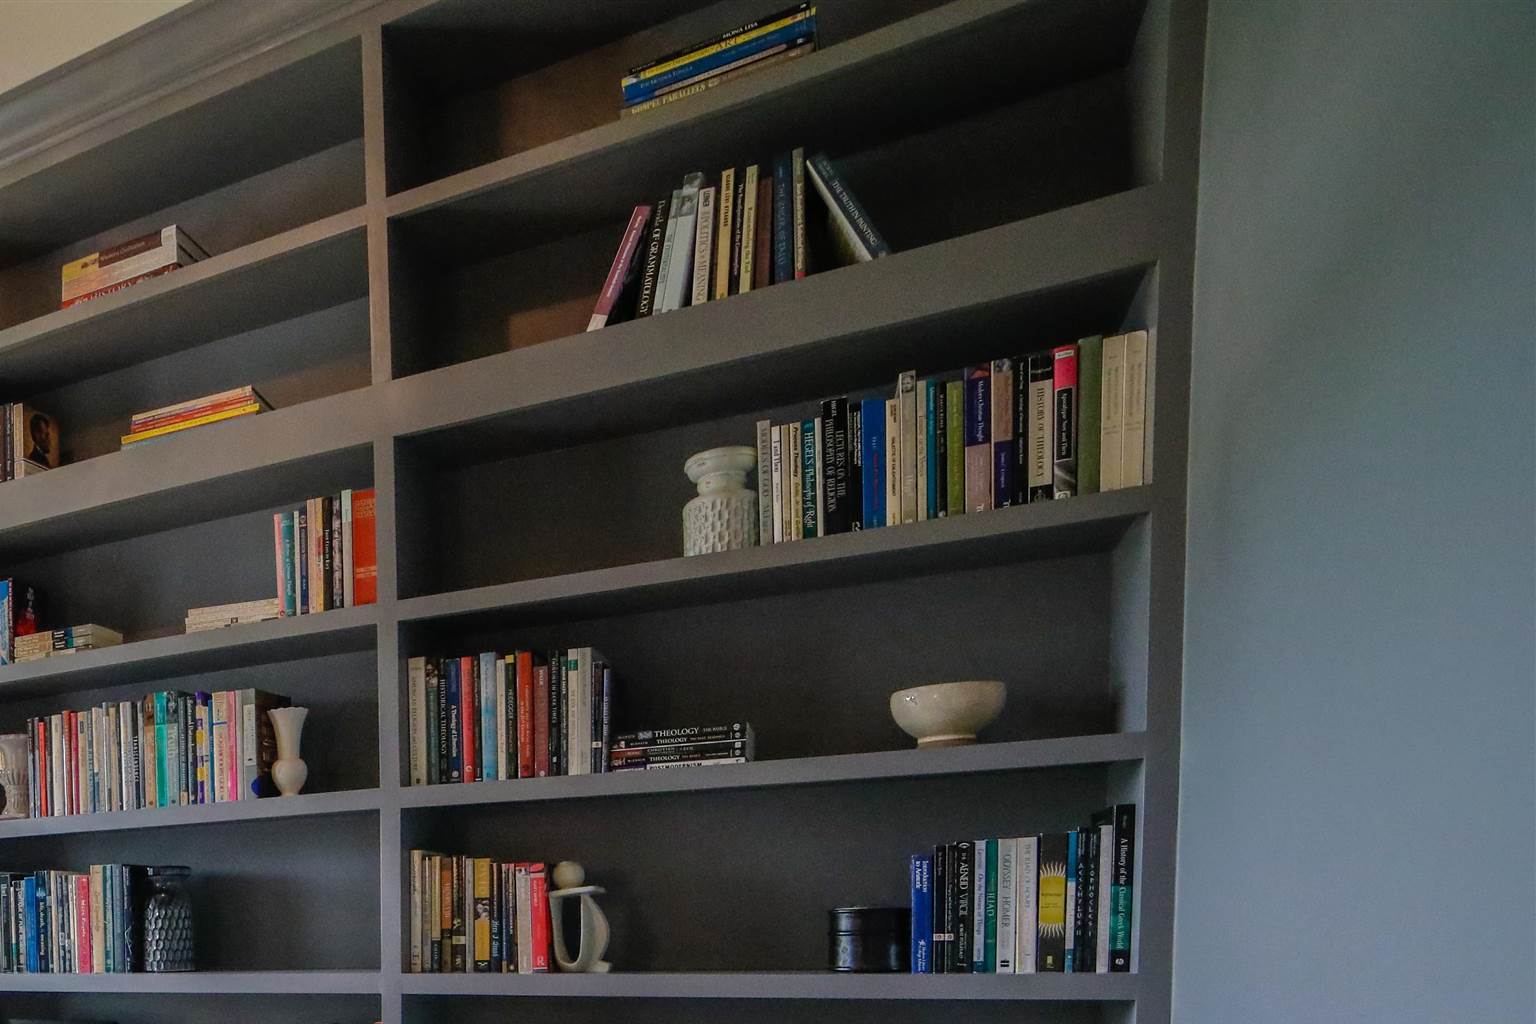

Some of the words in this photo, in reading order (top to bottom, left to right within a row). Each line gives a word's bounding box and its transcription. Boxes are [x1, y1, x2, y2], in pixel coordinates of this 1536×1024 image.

[631, 100, 661, 114] GOSPEL
[662, 84, 706, 104] PARALLELS
[838, 192, 853, 211] TRUTH
[854, 217, 878, 247] PAINTING
[652, 228, 661, 240] OF
[640, 242, 659, 314] GRAMMATOLOGY
[696, 260, 706, 303] MEANING
[1036, 387, 1045, 420] HISTORY
[824, 419, 835, 464] PHILOSOPHY
[1036, 423, 1045, 433] OF
[804, 432, 814, 465] HEGEL'S
[835, 430, 845, 467] LECTURES
[1036, 435, 1045, 478] THEOLOGY
[802, 468, 814, 500] Philosophy
[825, 466, 835, 476] OF
[836, 468, 845, 479] ON
[826, 478, 837, 513] RELIGION
[837, 482, 846, 498] THE
[803, 511, 815, 529] Right
[439, 679, 447, 718] HISTORICAL
[507, 688, 515, 719] HEIDEGGER
[439, 720, 447, 755] THEOLOGY
[654, 727, 700, 738] THEOLOGY
[656, 737, 688, 745] THEOLOGY
[1119, 845, 1128, 867] History
[915, 867, 923, 889] Aristotle
[921, 860, 929, 892] Introduction
[959, 862, 969, 891] AENEID
[976, 874, 984, 883] On
[1001, 854, 1012, 890] ODYSSEY
[1119, 875, 1127, 884] the
[959, 893, 969, 917] VIRGIL
[986, 893, 995, 917] ILIAD
[1000, 897, 1010, 929] HOMER
[1118, 887, 1127, 912] Classical
[975, 919, 984, 936] Things
[1117, 913, 1126, 930] Greek
[1116, 932, 1125, 950] World
